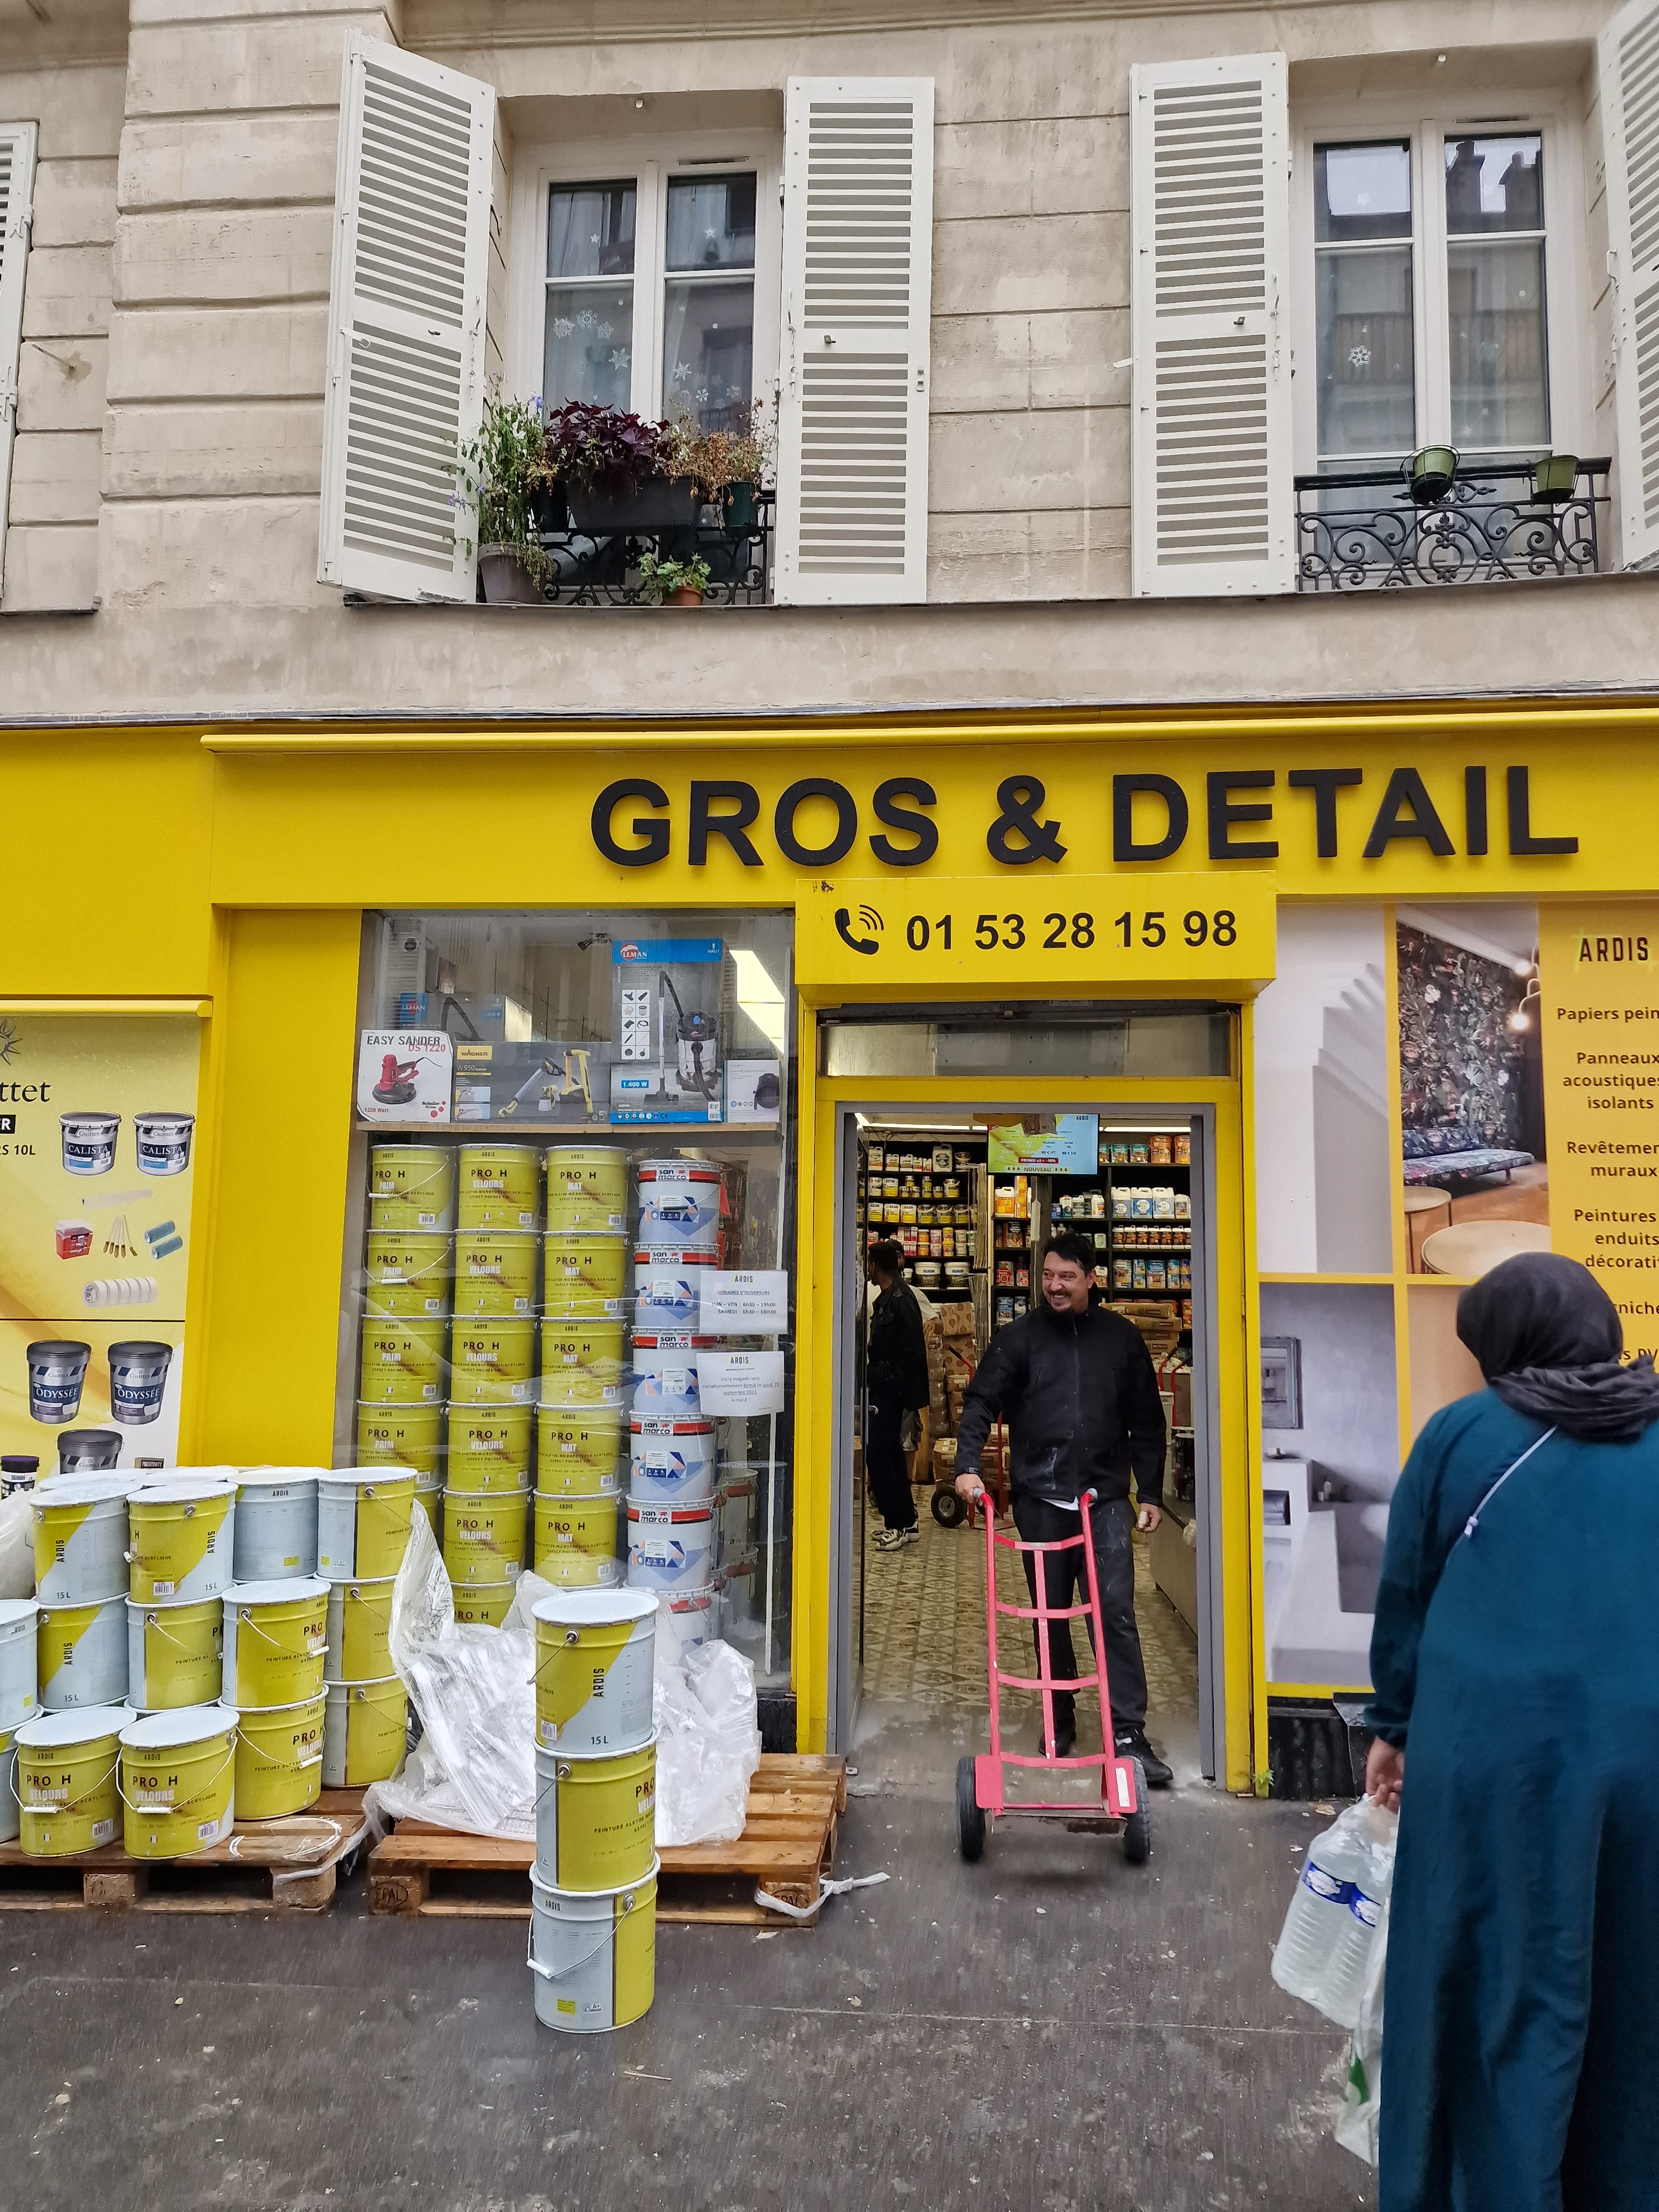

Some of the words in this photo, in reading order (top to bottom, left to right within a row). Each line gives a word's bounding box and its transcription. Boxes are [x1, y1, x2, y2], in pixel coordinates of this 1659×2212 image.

[590, 777, 939, 868] GROS
[986, 774, 1068, 866] &
[1112, 765, 1579, 862] DETAIL
[906, 914, 952, 951] 01
[974, 914, 1025, 950] 53
[1042, 912, 1095, 949] 28
[1114, 911, 1166, 948] 15
[1182, 910, 1237, 947] 98
[1579, 937, 1648, 962] ARDIS
[1557, 1007, 1619, 1023] Papiers
[367, 1036, 394, 1045] EASY
[398, 1036, 440, 1045] SANDER
[1577, 1052, 1659, 1064] Panneaux
[1563, 1074, 1659, 1090] acoustique
[1587, 1096, 1654, 1109] isolants
[0, 1118, 12, 1130] R
[14, 1145, 35, 1155] 10L
[68, 1145, 108, 1155] CALISTA
[143, 1145, 182, 1155] CALISTA
[1591, 1166, 1658, 1177] muraux
[1574, 1208, 1656, 1222] Peintures
[1595, 1232, 1659, 1245] enduits
[566, 1267, 580, 1275] MAT
[564, 1354, 578, 1363] MAT
[36, 1387, 78, 1399] ODYSSÉE
[117, 1387, 159, 1399] ODYSSÉE
[368, 1429, 388, 1437] PRO
[375, 1441, 394, 1449] PRIM
[471, 1441, 503, 1449] VELOURS
[561, 1443, 576, 1452] MAT
[457, 1520, 478, 1528] PRO
[549, 1522, 570, 1530] PRO
[460, 1531, 491, 1539] VELOURS
[558, 1533, 573, 1542] MAT
[56, 1540, 65, 1562] ARDIS
[304, 1622, 322, 1636] PRO
[64, 1642, 72, 1665] ARDIS
[593, 1668, 604, 1697] ARDIS
[293, 1730, 316, 1745] PRO
[591, 1736, 601, 1745] 15
[27, 1775, 51, 1786] PRO
[62, 1774, 71, 1785] H
[133, 1776, 158, 1787] PRO
[169, 1775, 178, 1786] H
[636, 1777, 654, 1797] PRO
[594, 1824, 623, 1833] PEINTURE
[545, 1900, 560, 1911] ARDIS
